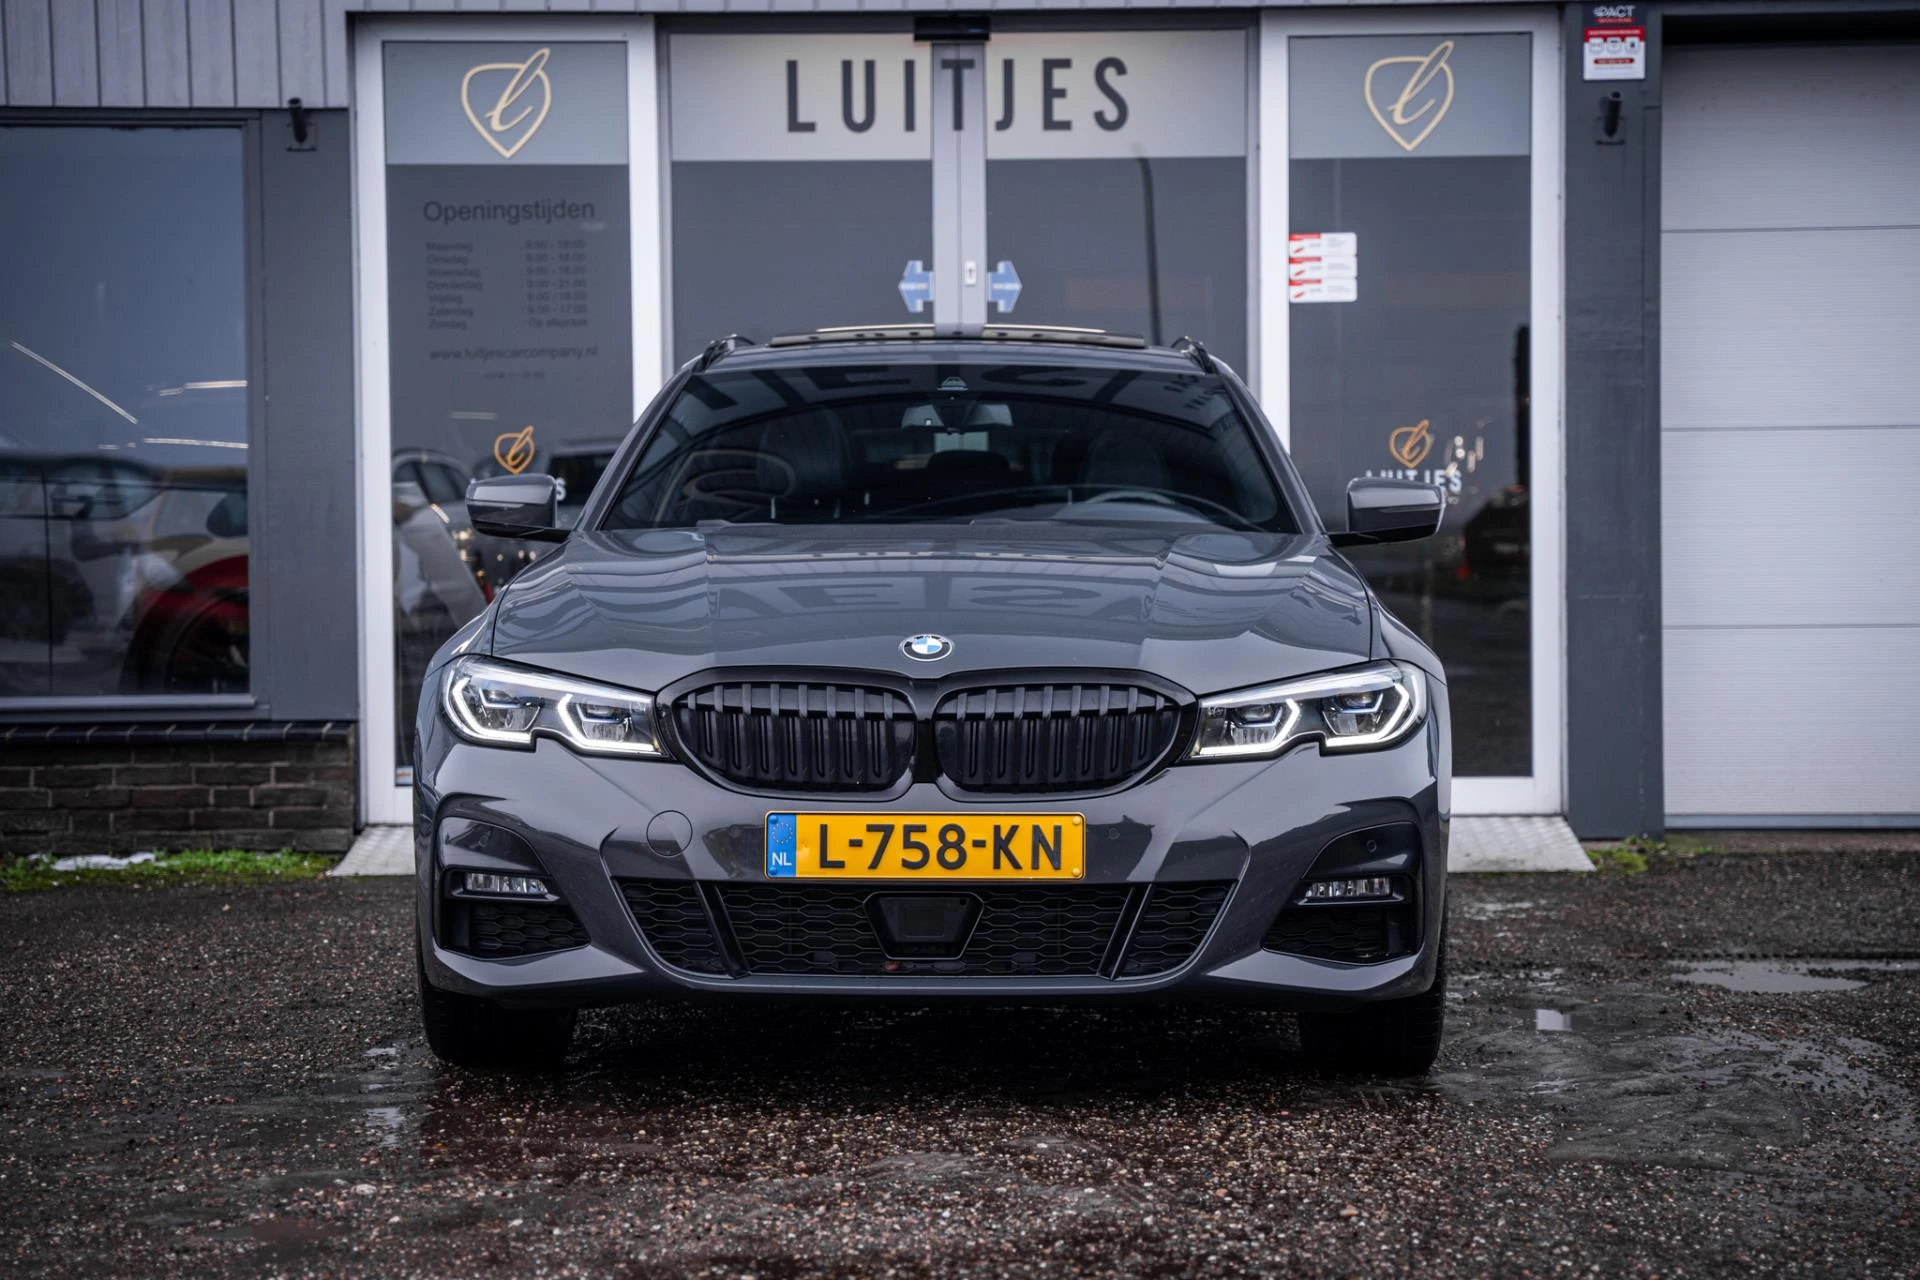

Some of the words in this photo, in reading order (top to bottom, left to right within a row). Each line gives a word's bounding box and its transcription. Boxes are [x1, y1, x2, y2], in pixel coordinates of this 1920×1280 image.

[786, 57, 1129, 133] LUITJES
[423, 200, 595, 225] Openingstijden
[771, 852, 792, 867] NL
[819, 824, 1062, 870] L-758-KN
